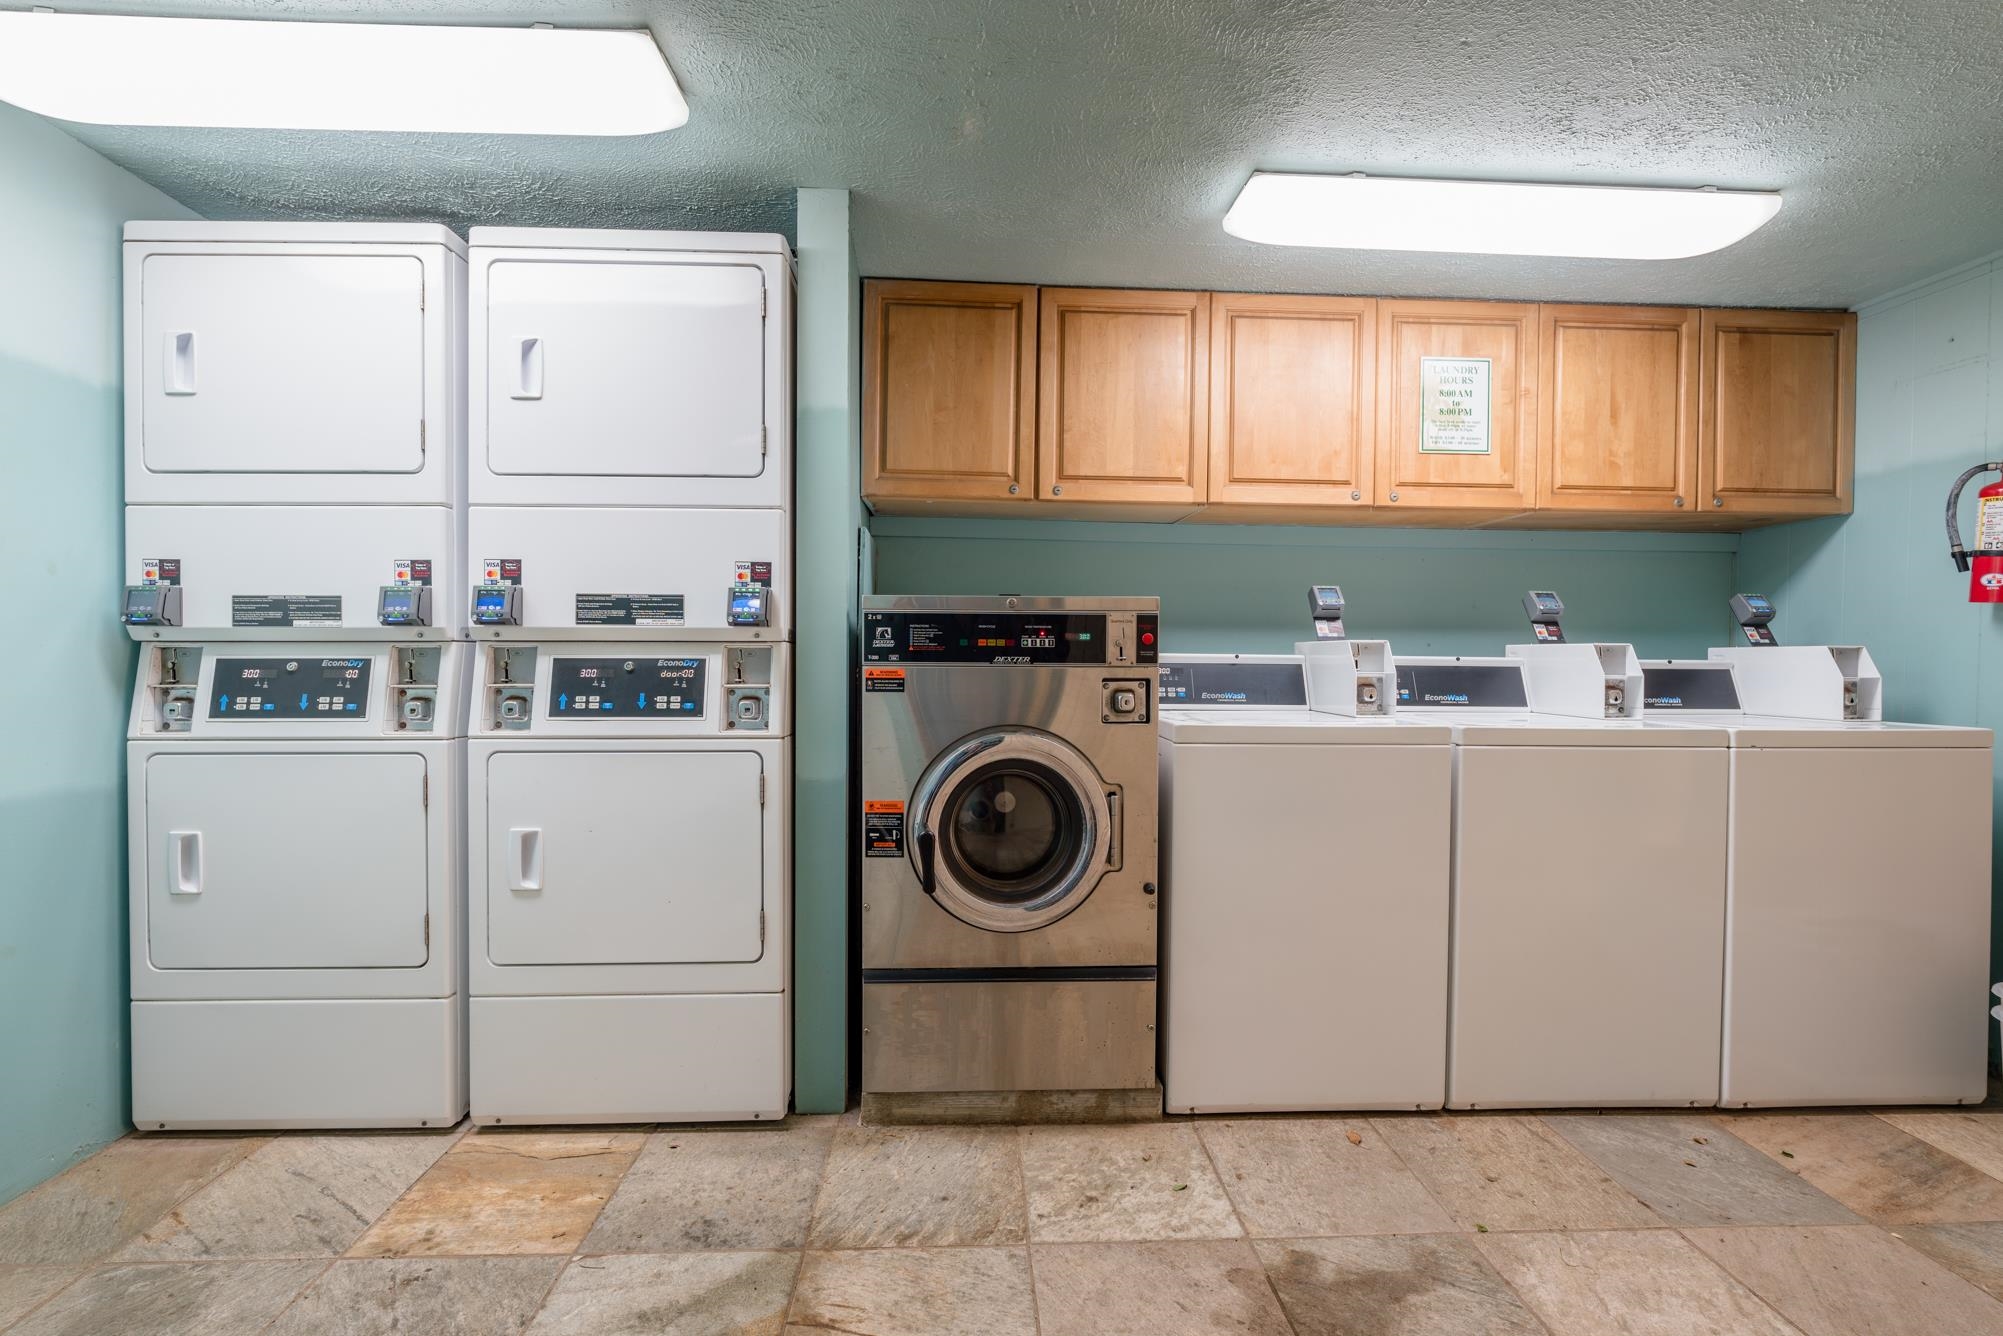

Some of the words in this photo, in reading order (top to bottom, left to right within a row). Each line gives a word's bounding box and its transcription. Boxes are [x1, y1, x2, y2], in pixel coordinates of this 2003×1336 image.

[1433, 365, 1480, 375] LAUNDRY
[1440, 376, 1474, 385] HOURS
[1439, 389, 1456, 398] 8:00
[1456, 389, 1473, 398] AM
[1439, 408, 1456, 416] 8:00
[1457, 408, 1473, 416] PM
[321, 659, 364, 668] EconoDry
[657, 659, 699, 668] EconoDry
[579, 669, 597, 678] 300
[1424, 693, 1468, 701] EconoWash
